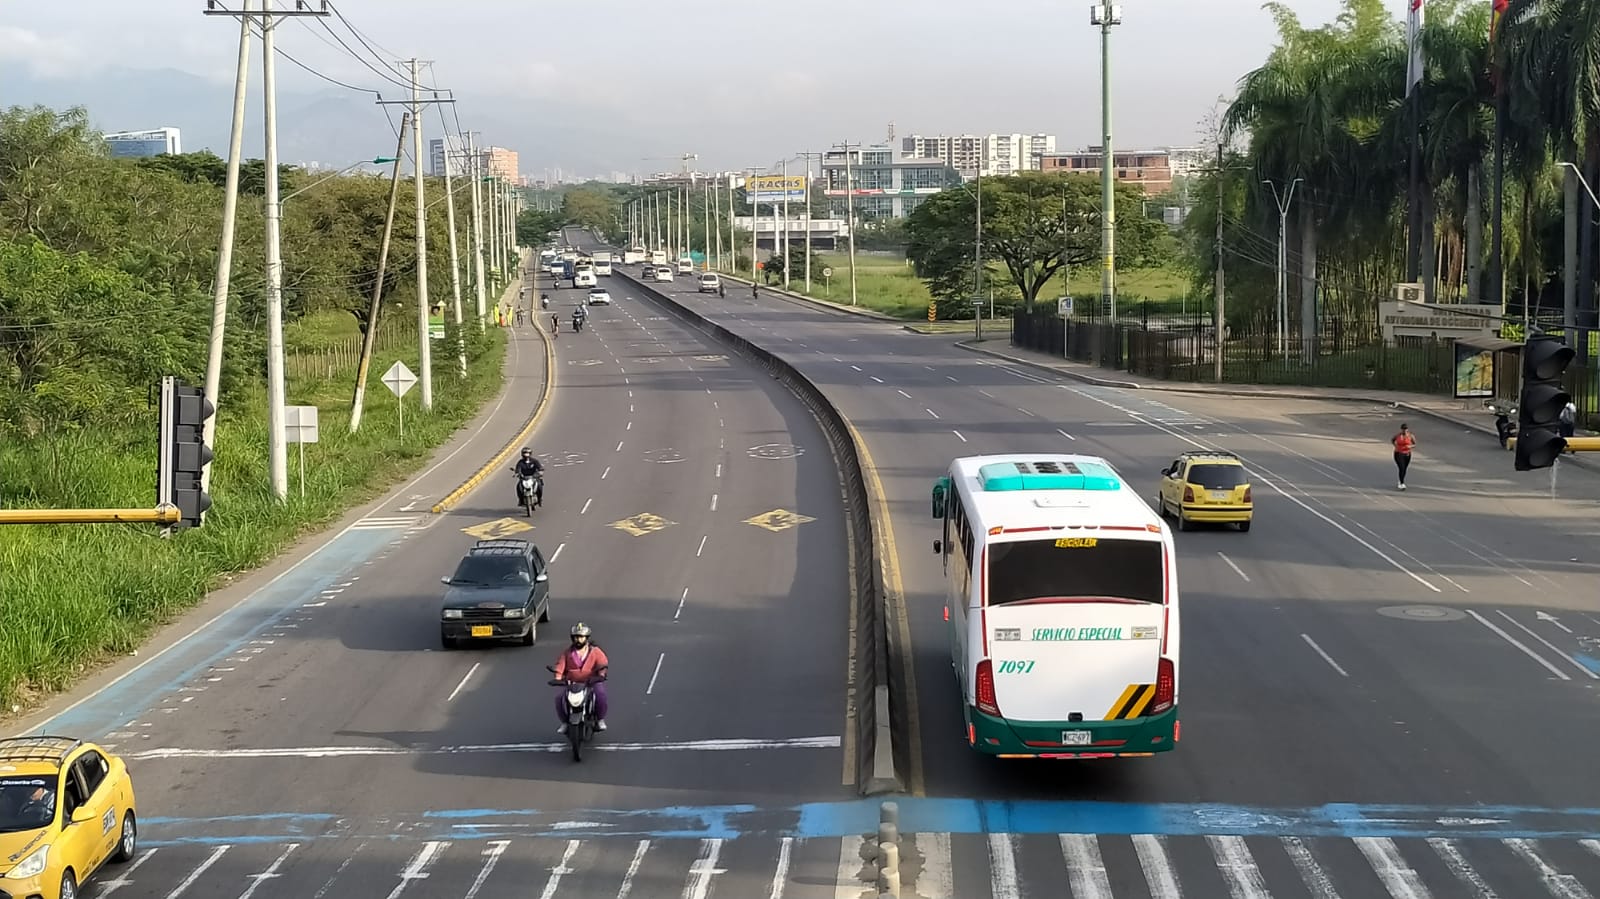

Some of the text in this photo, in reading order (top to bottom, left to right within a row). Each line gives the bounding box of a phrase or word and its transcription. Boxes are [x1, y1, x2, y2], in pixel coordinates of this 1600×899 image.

[1031, 628, 1076, 641] SERVICIO
[1077, 627, 1122, 640] ESPECIAL
[997, 660, 1035, 673] 7097
